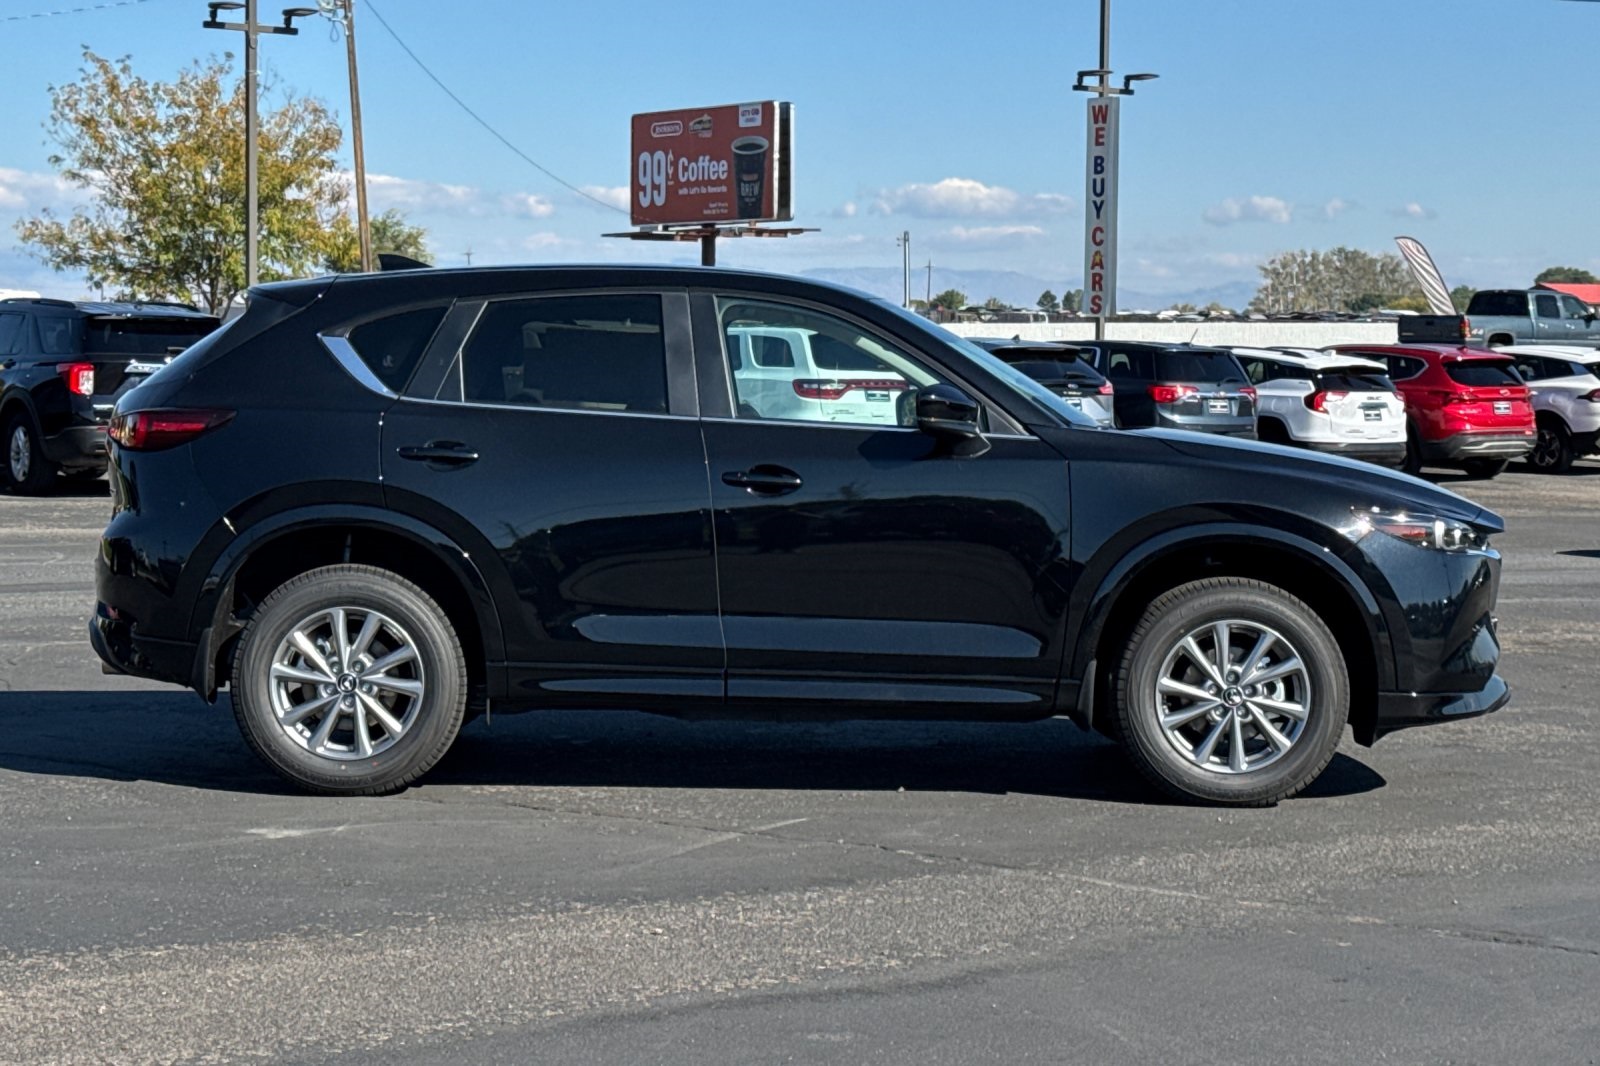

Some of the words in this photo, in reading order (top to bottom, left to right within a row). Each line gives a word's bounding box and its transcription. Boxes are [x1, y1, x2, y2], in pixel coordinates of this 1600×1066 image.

[1091, 104, 1109, 146] WE
[678, 154, 728, 182] Coffee
[740, 180, 760, 196] BREW
[1092, 155, 1105, 220] BUY
[1090, 226, 1104, 315] CARS
